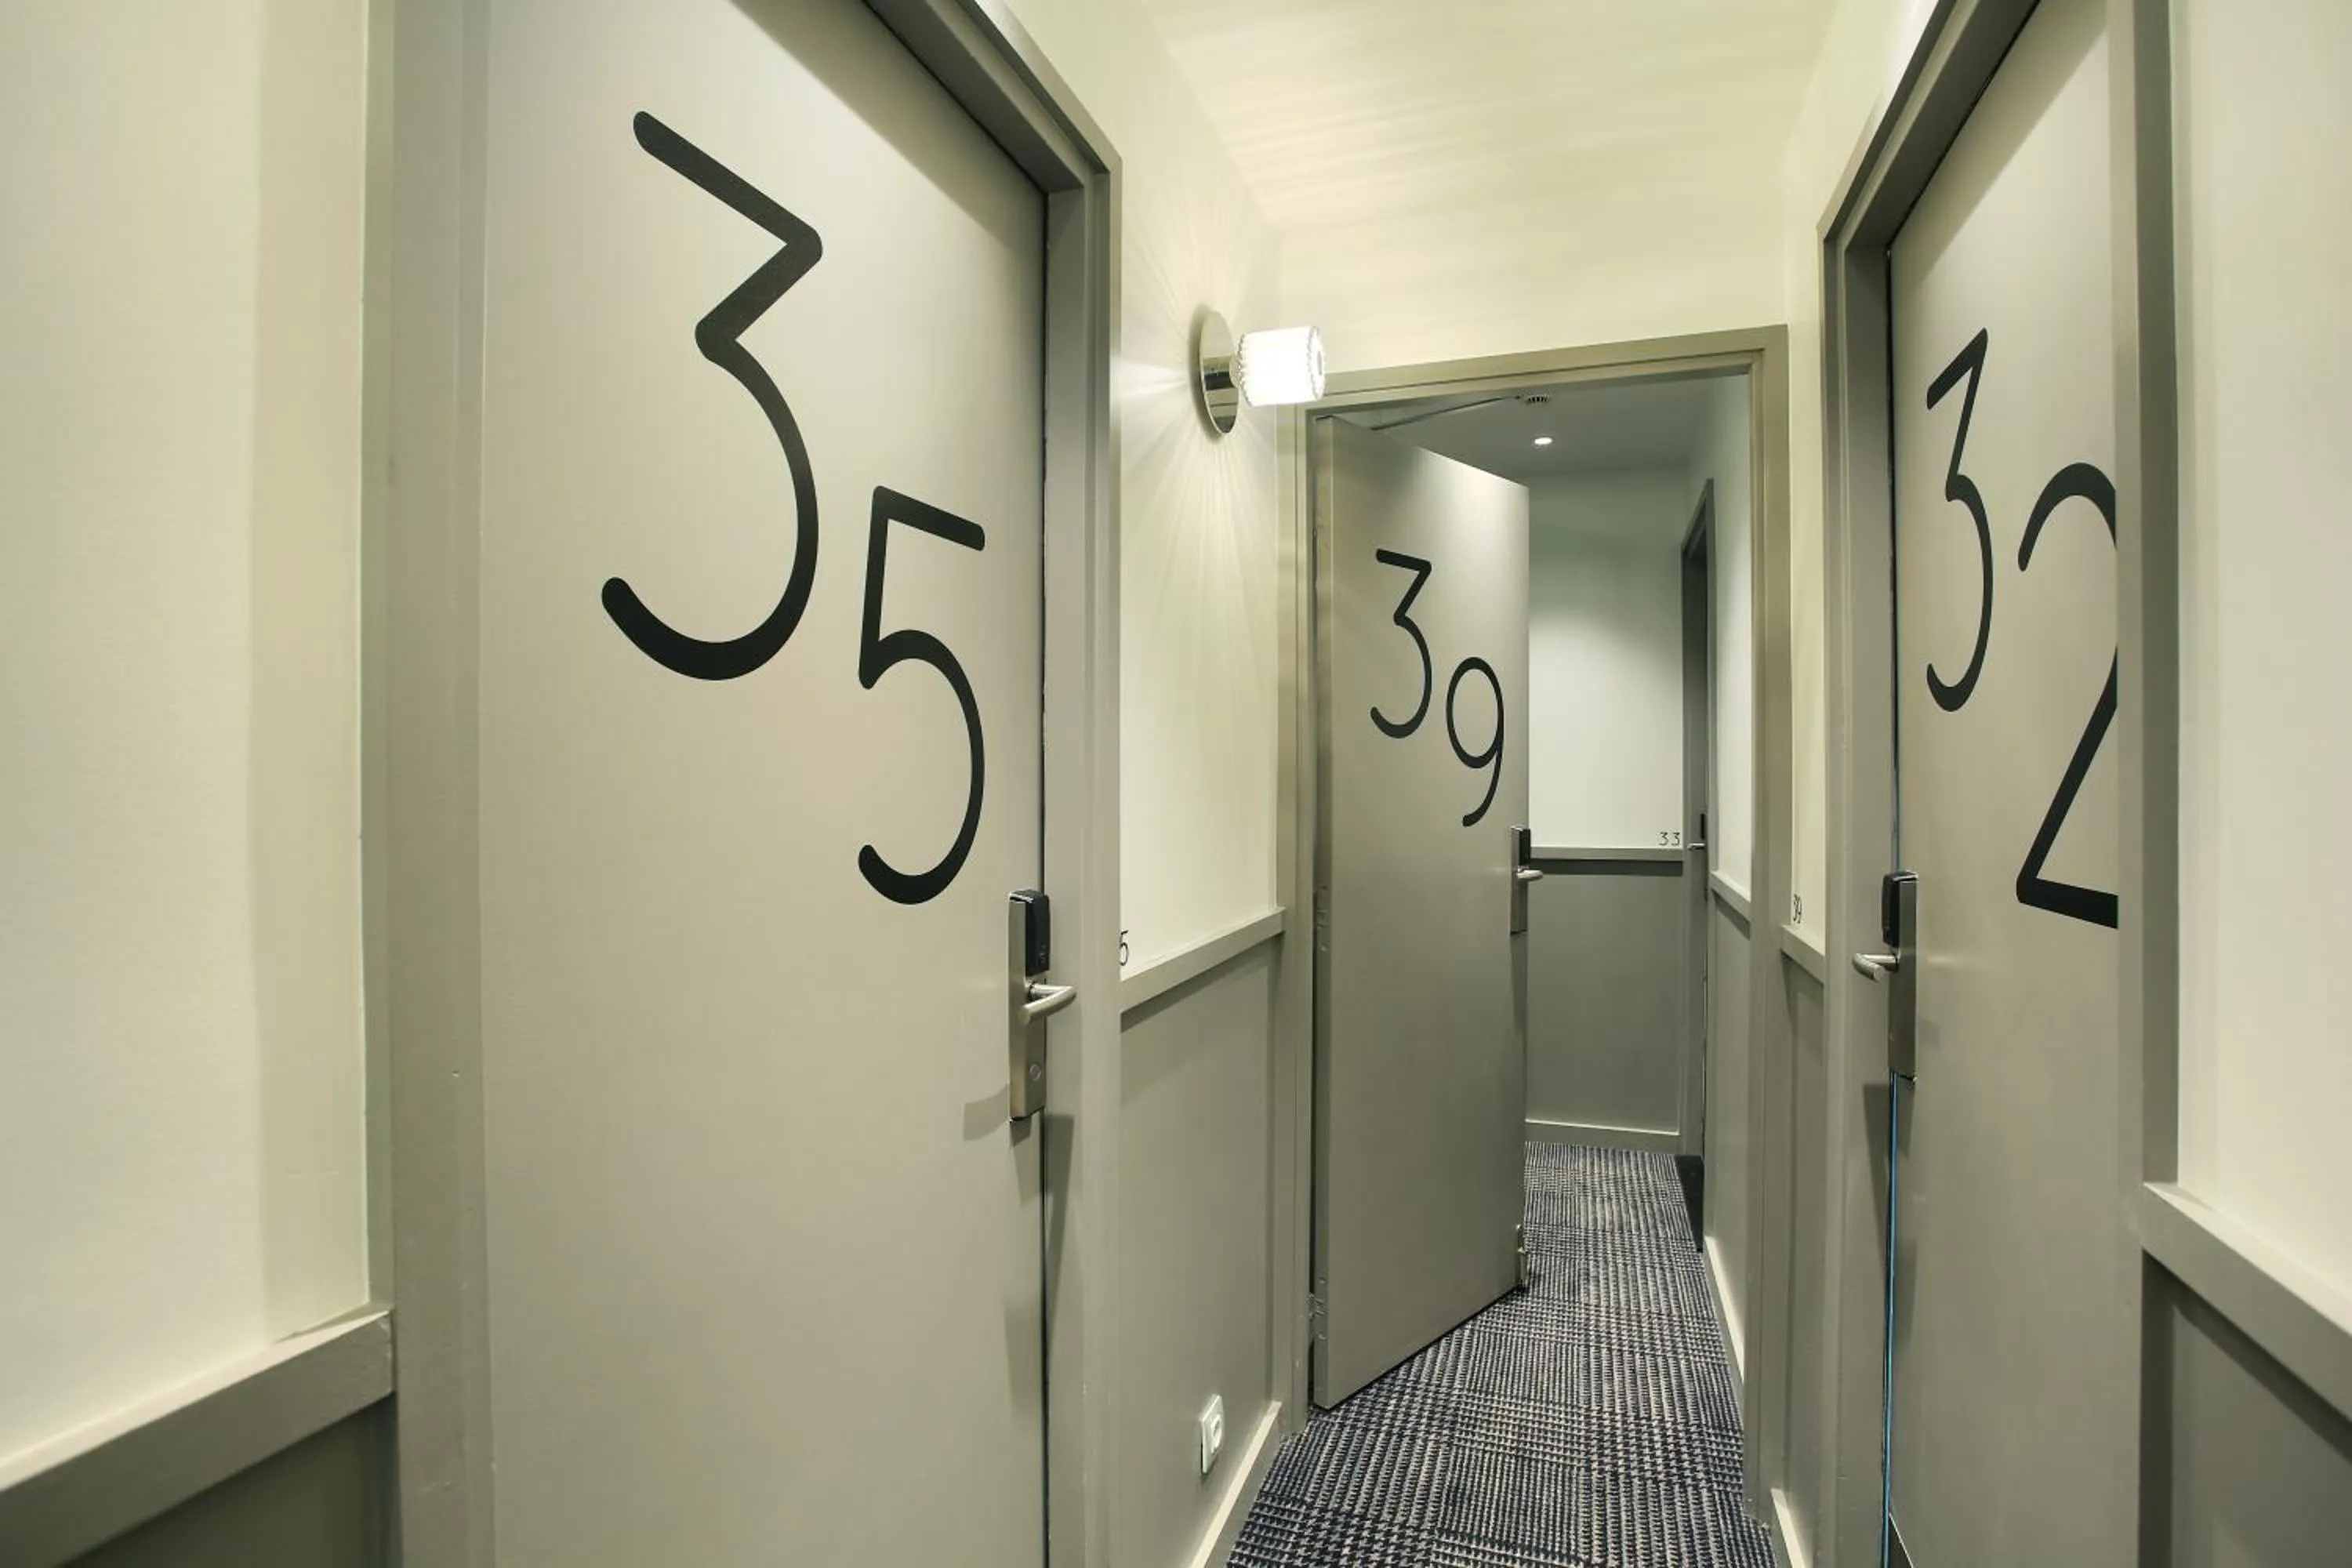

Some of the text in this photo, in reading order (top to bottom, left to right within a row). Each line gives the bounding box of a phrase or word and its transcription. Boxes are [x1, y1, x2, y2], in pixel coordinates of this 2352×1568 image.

[601, 111, 985, 904] 35
[1370, 549, 1504, 827] 39
[1926, 328, 2118, 928] 32
[1658, 832, 1681, 846] 33
